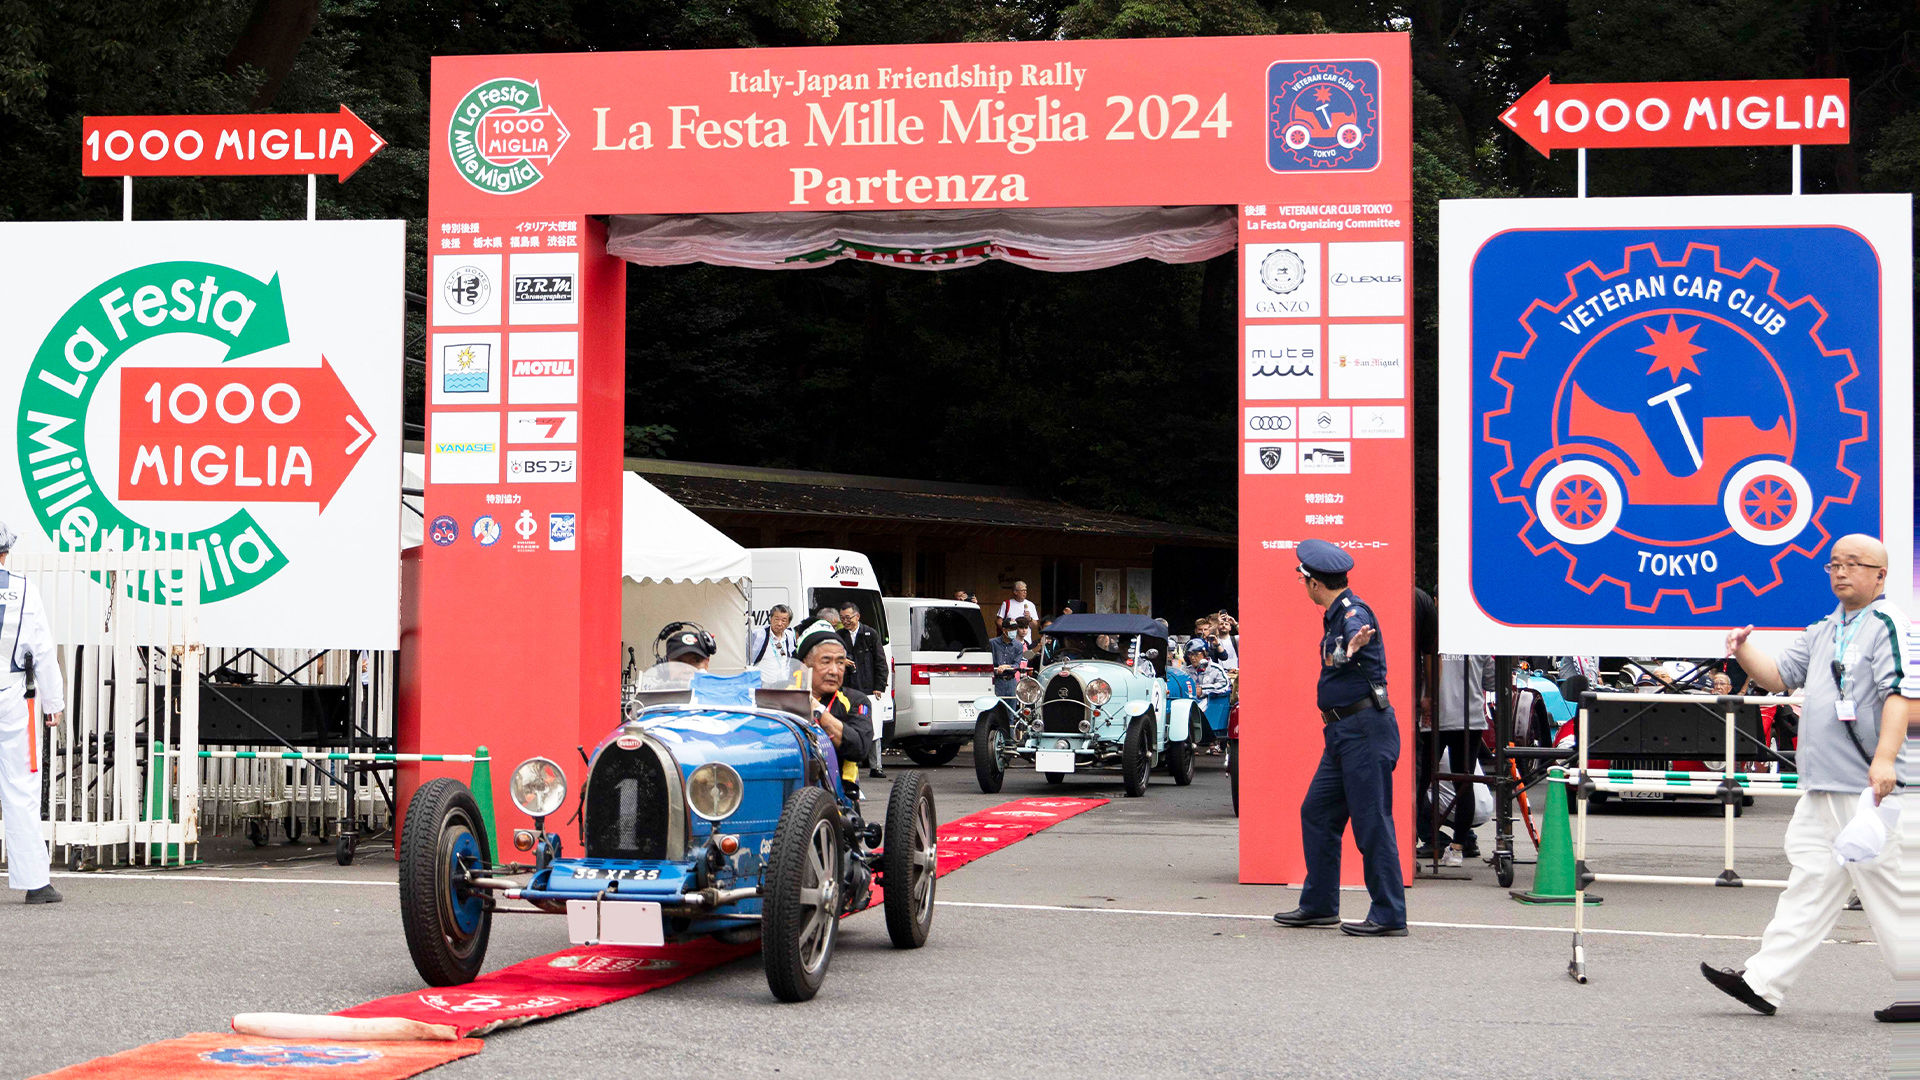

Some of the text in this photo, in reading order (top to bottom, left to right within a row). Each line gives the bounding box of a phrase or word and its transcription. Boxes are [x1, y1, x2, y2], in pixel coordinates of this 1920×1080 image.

[729, 61, 1087, 98] Italy-Japan Friendship Rally
[1292, 73, 1355, 92] VETERAN CAR CLUB
[458, 85, 529, 126] La Festa
[1533, 95, 1846, 133] 1000 MIGLIA
[493, 118, 544, 134] 1000
[592, 92, 1233, 154] La Festa Mille Miglia 2024
[86, 128, 354, 162] 1000 MIGLIA
[488, 138, 548, 153] MIGLIA
[1313, 149, 1336, 157] TOKYO
[454, 130, 535, 191] Mille Miglia
[789, 167, 1029, 205] Partenza
[1245, 205, 1266, 216] 後援
[1279, 204, 1392, 216] VETERAN CAR CLUB TOKYO
[441, 223, 480, 234] 特別後援
[516, 221, 577, 232] イタリア大使館
[1247, 218, 1400, 231] La Festa Organizing Committee
[441, 238, 461, 249] 後援
[473, 237, 502, 248] 栃木県
[510, 236, 540, 247] 福島県
[547, 235, 577, 247] 渋谷区
[516, 278, 571, 293] B.R.M
[1350, 275, 1402, 283] LEXUS
[1256, 301, 1310, 312] GANZO
[1560, 274, 1787, 336] VETERAN CAR CLUB
[38, 275, 257, 398] La Festa
[1252, 347, 1314, 358] muta
[514, 361, 572, 375] MOTUL
[1353, 358, 1400, 368] San Miguel
[144, 382, 301, 424] 1000
[438, 444, 493, 452] YANASE
[130, 444, 312, 487] MIGLIA
[27, 410, 98, 547] Mille
[486, 494, 522, 504] 特別協力
[1305, 493, 1344, 504] 特別協力
[1305, 514, 1344, 525] 明治神宮
[1637, 550, 1718, 577] TOKYO
[614, 778, 640, 851] 1
[574, 868, 660, 880] 35 XF 25
